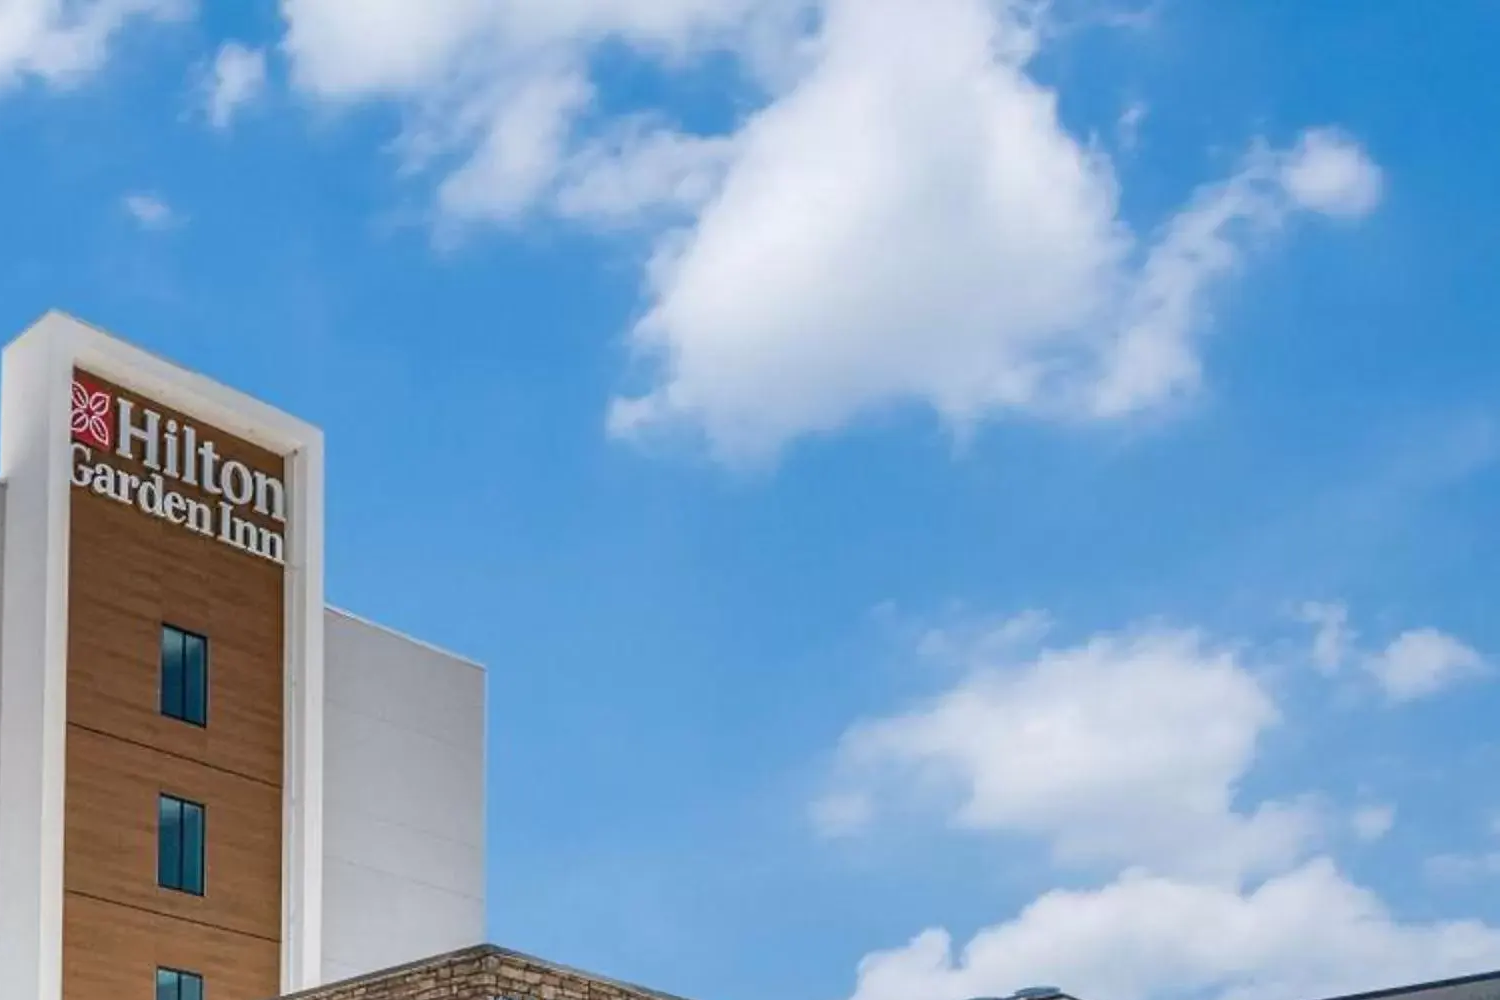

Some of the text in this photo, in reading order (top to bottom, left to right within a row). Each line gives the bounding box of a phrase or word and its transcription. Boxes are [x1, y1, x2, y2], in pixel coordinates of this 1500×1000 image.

[70, 442, 285, 565] Garden Inn
[116, 397, 286, 522] Hilton
